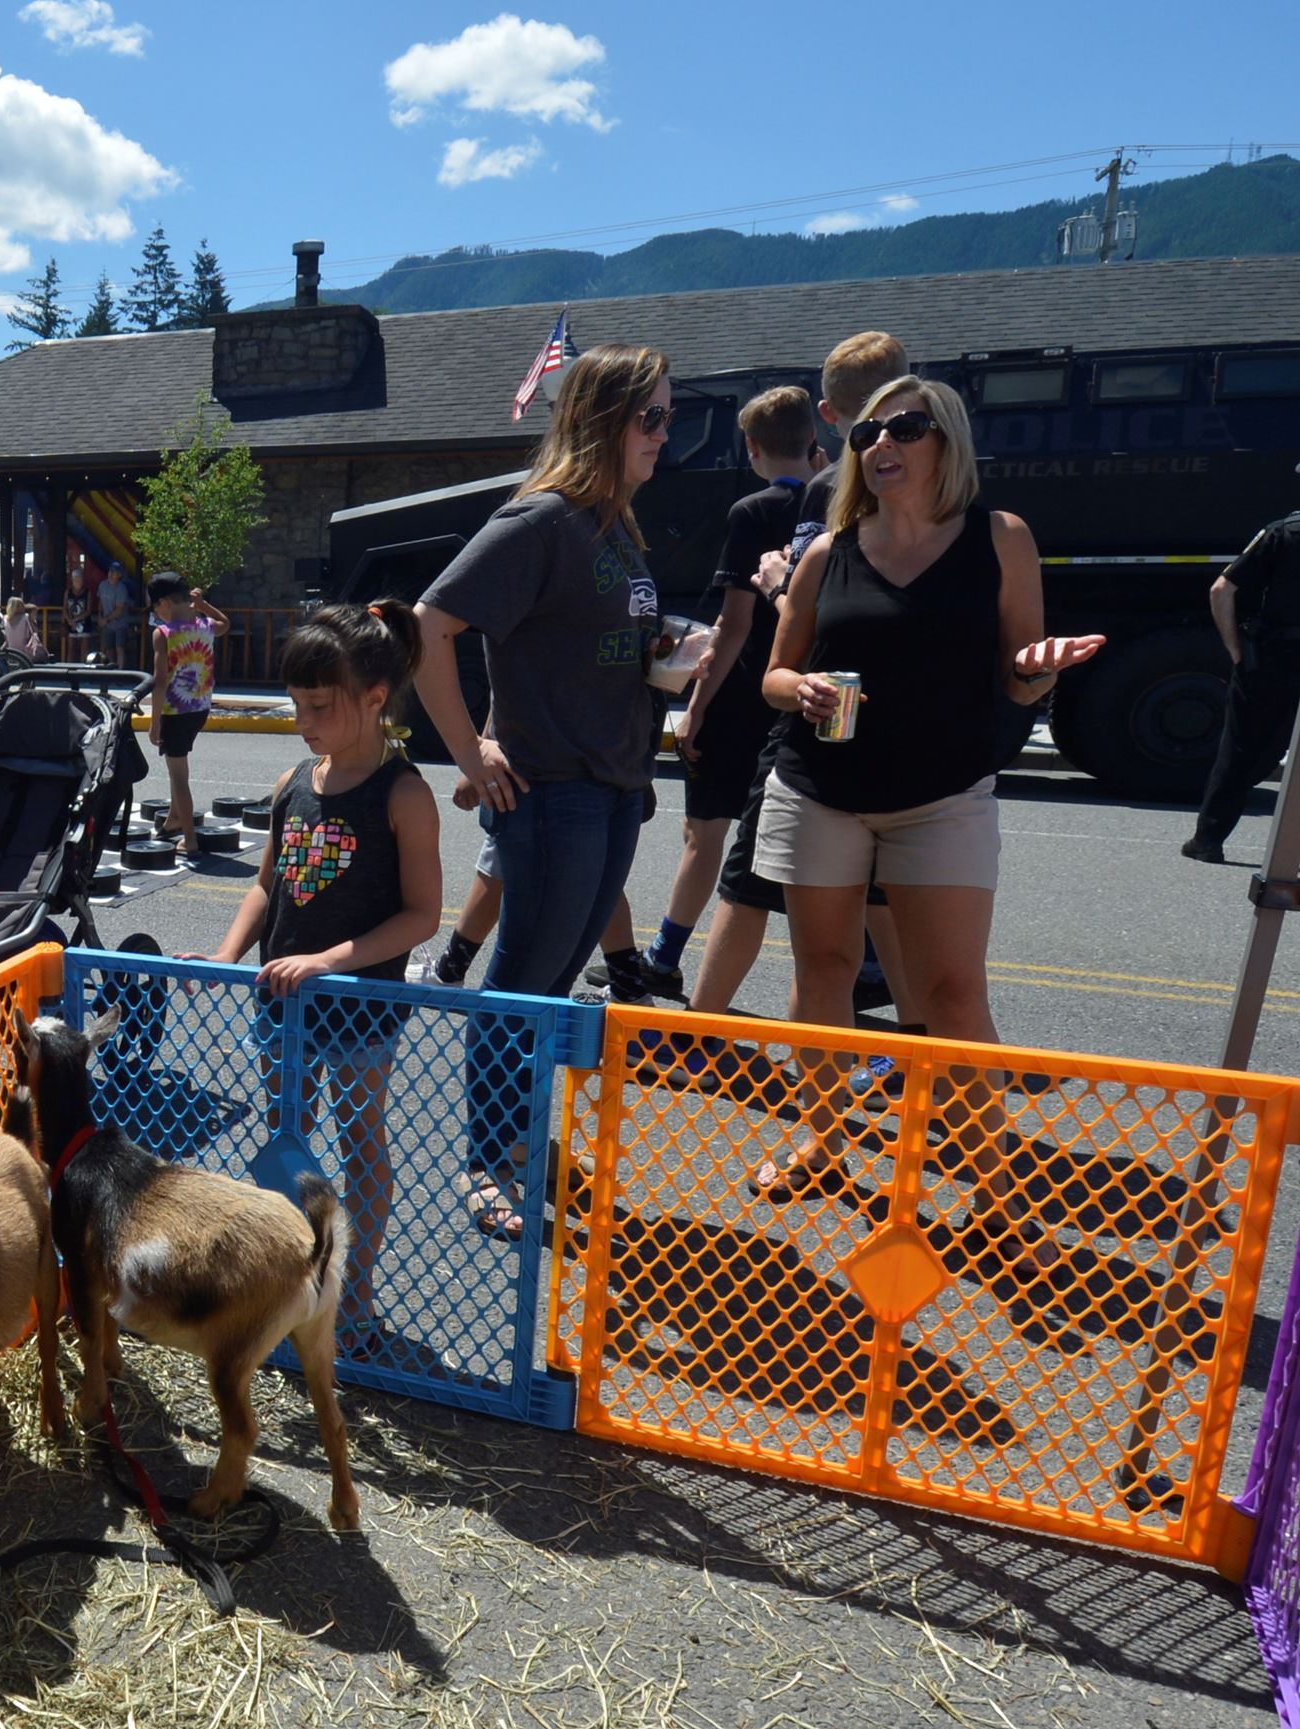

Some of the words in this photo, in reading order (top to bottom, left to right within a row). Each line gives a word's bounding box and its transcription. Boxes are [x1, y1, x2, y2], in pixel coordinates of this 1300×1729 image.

[972, 405, 1230, 450] OLICE
[978, 460, 1081, 479] CTICAL
[1092, 456, 1211, 475] RESCUE
